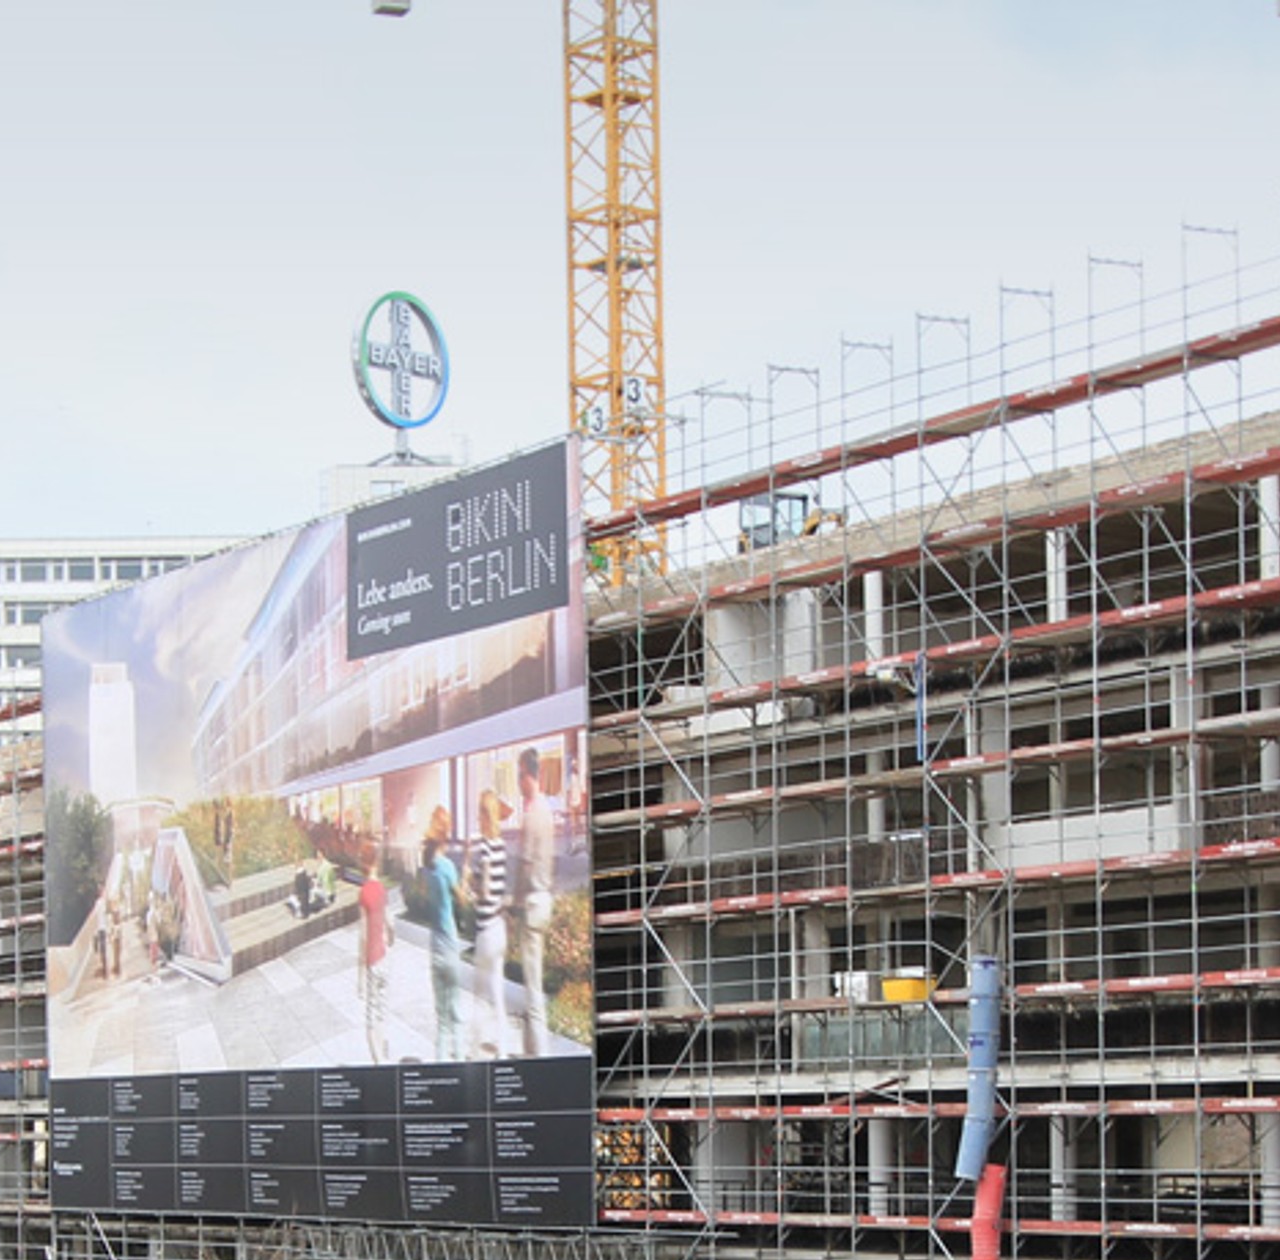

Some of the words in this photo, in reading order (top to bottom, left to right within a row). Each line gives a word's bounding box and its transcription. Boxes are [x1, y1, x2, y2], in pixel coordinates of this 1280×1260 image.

[368, 345, 441, 378] BAYER
[627, 378, 641, 402] 3
[591, 407, 604, 432] 3
[446, 480, 530, 553] BIKINI
[447, 533, 556, 612] BERLIN
[357, 578, 387, 609] Lebe
